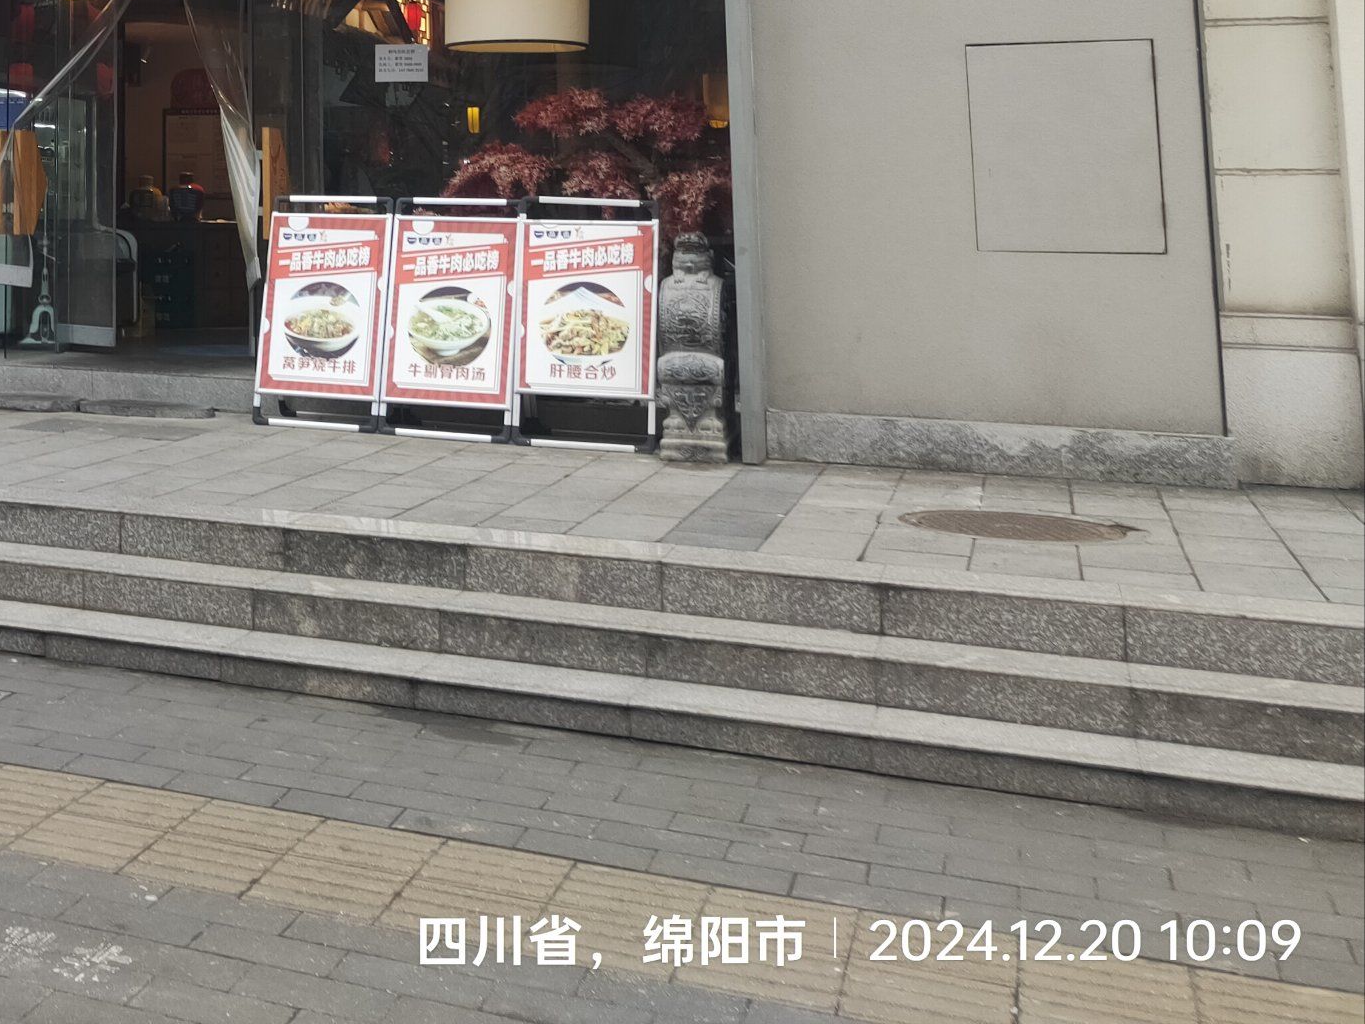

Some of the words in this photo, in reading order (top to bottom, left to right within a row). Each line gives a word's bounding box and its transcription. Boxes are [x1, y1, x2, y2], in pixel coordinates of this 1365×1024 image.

[279, 246, 371, 272] 一品香牛肉必吃榜
[402, 249, 500, 277] 一品香牛肉必吃榜
[531, 242, 634, 272] 一品香牛肉必吃榜
[282, 356, 357, 374] 莴笋烧牛排
[549, 364, 617, 380] 肝腰合炒
